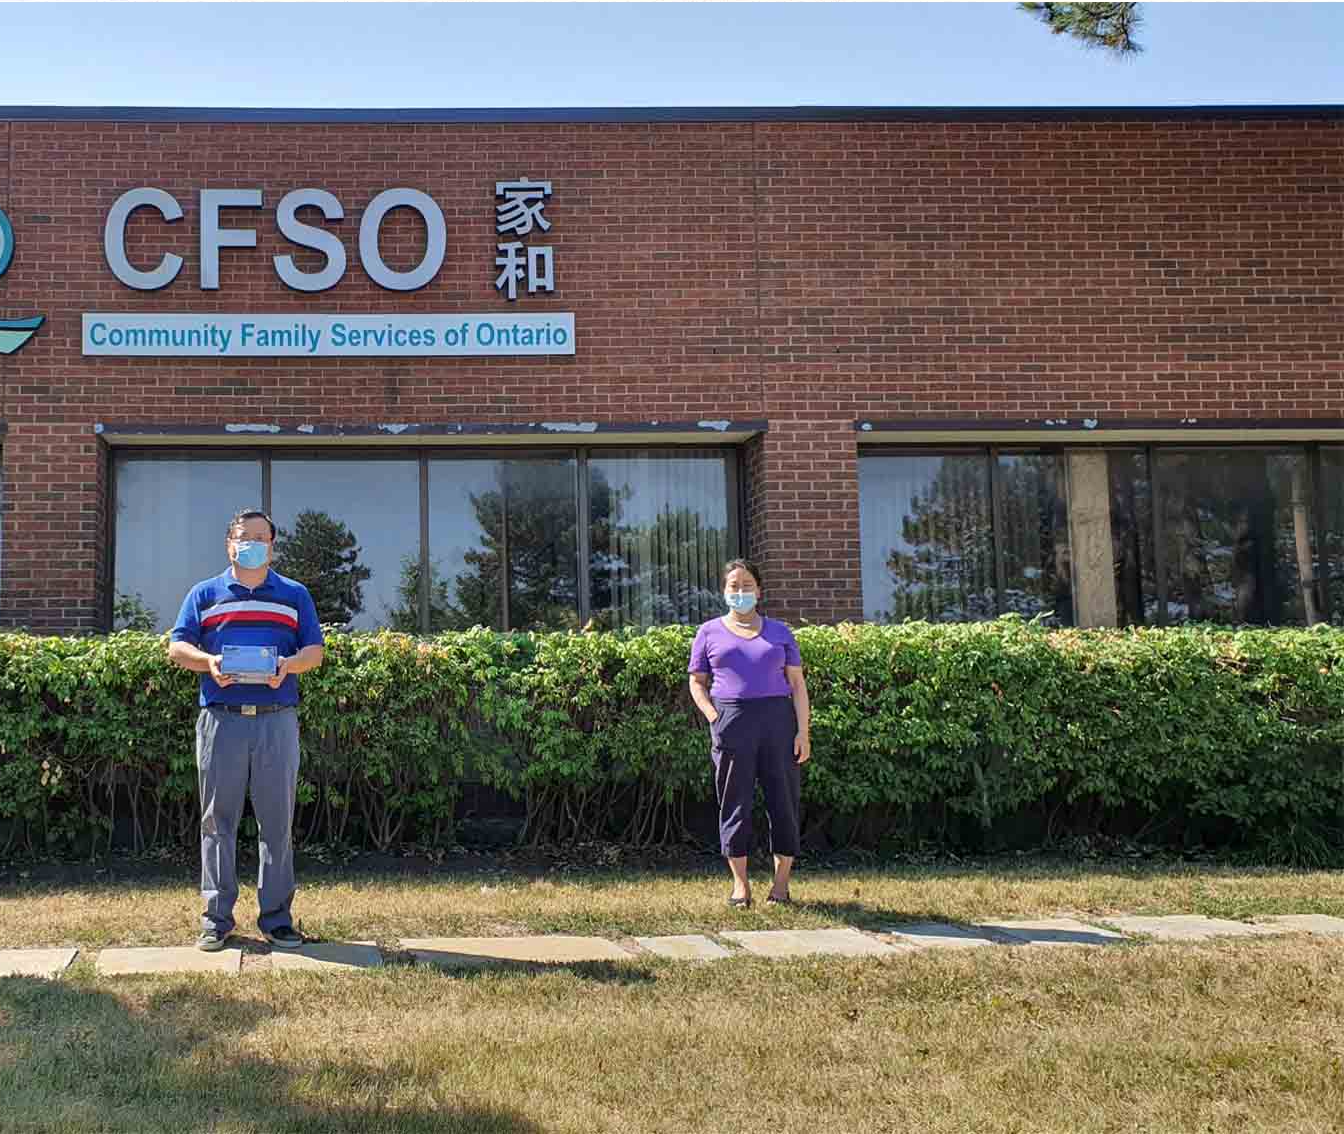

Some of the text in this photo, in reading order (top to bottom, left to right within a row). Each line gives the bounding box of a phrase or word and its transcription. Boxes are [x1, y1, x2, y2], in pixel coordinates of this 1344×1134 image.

[103, 187, 448, 293] CFSO
[494, 175, 555, 301] 家和
[88, 321, 568, 353] Community Family Services of Ontario
